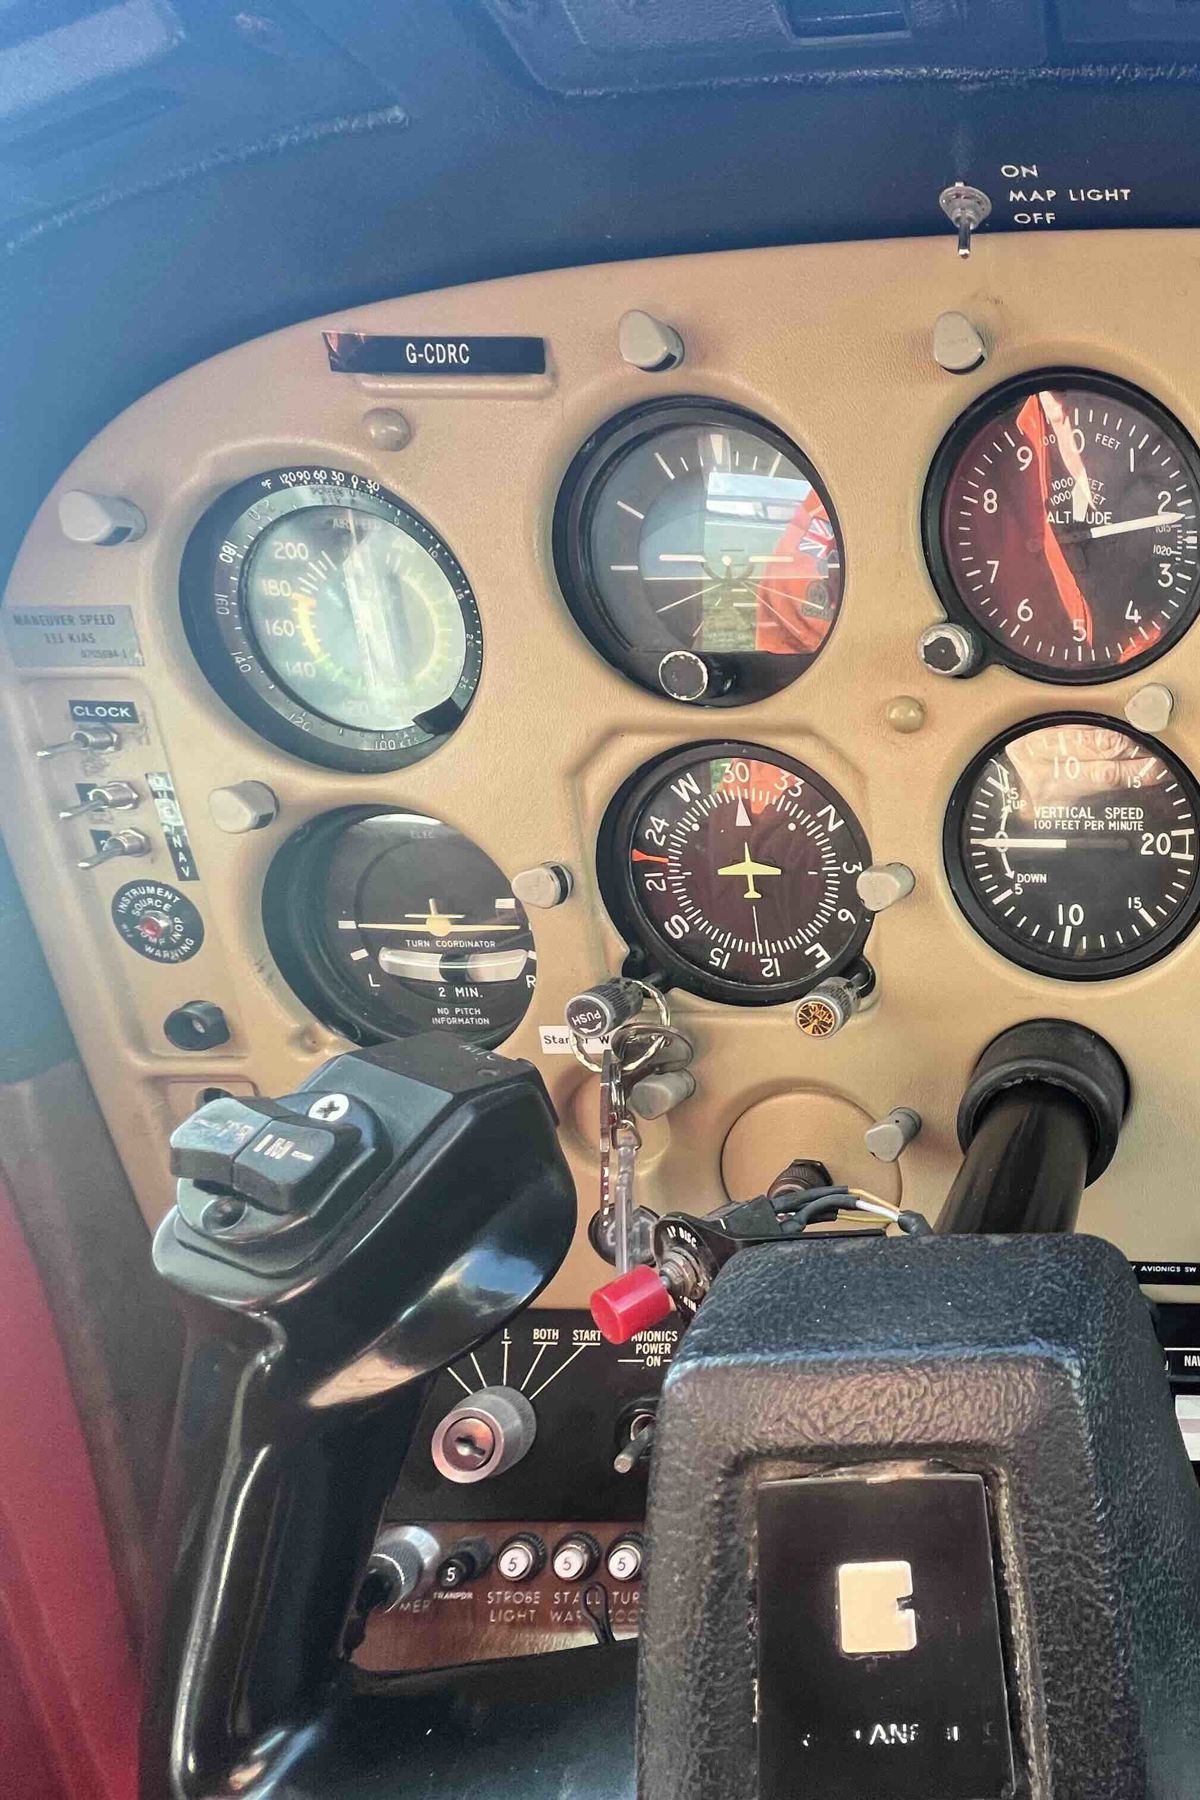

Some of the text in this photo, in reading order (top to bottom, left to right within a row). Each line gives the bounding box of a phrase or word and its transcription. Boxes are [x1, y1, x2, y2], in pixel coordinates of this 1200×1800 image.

[1002, 165, 1038, 178] ON
[1009, 188, 1131, 202] MAP LIGHT
[1014, 212, 1055, 224] OFF
[406, 344, 470, 365] G-CDRC
[1017, 446, 1032, 471] 9
[1130, 448, 1134, 472] 1
[983, 489, 998, 513] 8
[1157, 491, 1171, 515] 2
[1046, 511, 1112, 524] ALTUDE
[273, 543, 308, 559] 200
[1153, 546, 1172, 556] 1020
[987, 561, 998, 583] 7
[1157, 563, 1173, 587] 3
[262, 580, 291, 597] 180
[1017, 598, 1033, 621] 6
[1125, 601, 1141, 622] 4
[13, 614, 75, 626] MANEUVER
[265, 620, 294, 637] 160
[1073, 619, 1087, 642] 5
[74, 706, 131, 717] CLOCK
[722, 762, 750, 783] 30
[1054, 757, 1080, 780] 10
[774, 770, 805, 797] 33
[1034, 807, 1143, 819] VERTICAL SPEED
[1034, 820, 1144, 831] 100 FEET PER MINUTE
[1140, 832, 1171, 855] 20
[1017, 873, 1046, 883] DOWN
[117, 886, 181, 914] INSTRUMENT
[1058, 903, 1084, 926] 10
[435, 940, 495, 948] COORDINATOR
[439, 986, 483, 998] 2 MIN.
[432, 1016, 489, 1025] INFORMATION
[533, 1329, 559, 1340] BOTH
[573, 1330, 601, 1341] START
[631, 1331, 677, 1342] AVIONICS
[636, 1344, 671, 1354] POWER
[646, 1356, 661, 1366] ON
[487, 1592, 541, 1604] STROBE
[490, 1610, 535, 1623] LIGHT
